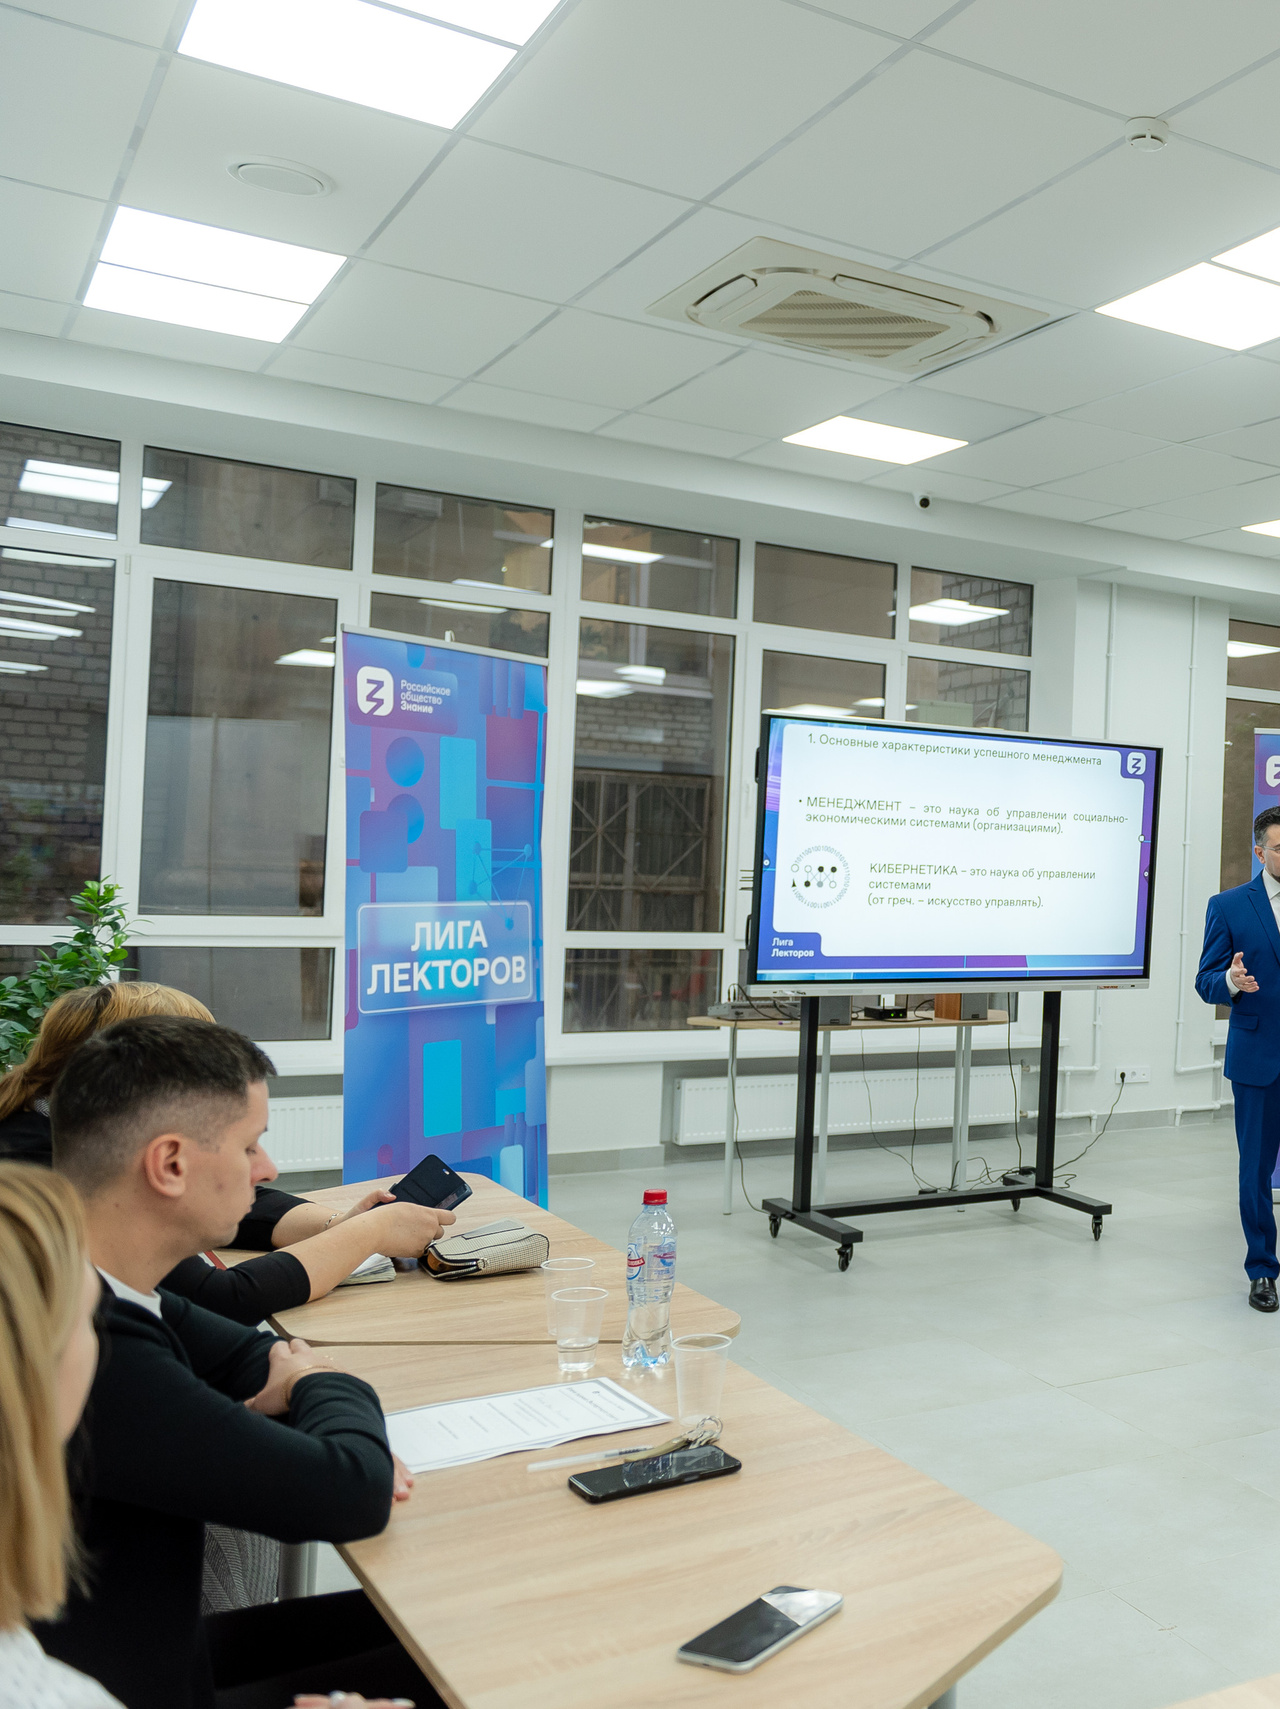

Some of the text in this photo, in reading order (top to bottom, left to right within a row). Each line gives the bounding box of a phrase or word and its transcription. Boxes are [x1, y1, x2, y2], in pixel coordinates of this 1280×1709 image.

[400, 679, 451, 696] Российское
[400, 691, 442, 705] общество
[400, 700, 433, 714] Знание
[807, 732, 1102, 766] 1. Основные характеристики успешного менеджмента
[806, 796, 902, 812] МЕНЕДЖМЕНТ
[923, 804, 942, 814] это
[948, 806, 980, 818] наука
[986, 806, 1000, 817] об
[1006, 809, 1067, 820] управлении
[1073, 813, 1129, 824] социально-
[805, 813, 1064, 835] экономическими системами (организациями).
[869, 863, 958, 876] КИБЕРНЕТИКА
[969, 868, 988, 877] это
[989, 869, 1019, 880] наука
[1021, 868, 1035, 878] об
[1036, 870, 1096, 881] управлении
[868, 880, 932, 890] системами
[867, 892, 885, 907] (от
[887, 897, 915, 907] греч.
[927, 897, 983, 908] искусство
[984, 896, 1044, 909] управлять).
[411, 920, 488, 952] ЛИГА
[771, 937, 794, 947] Лига
[771, 948, 815, 959] Лекторов
[366, 955, 526, 995] ЛЕКТОРОВ
